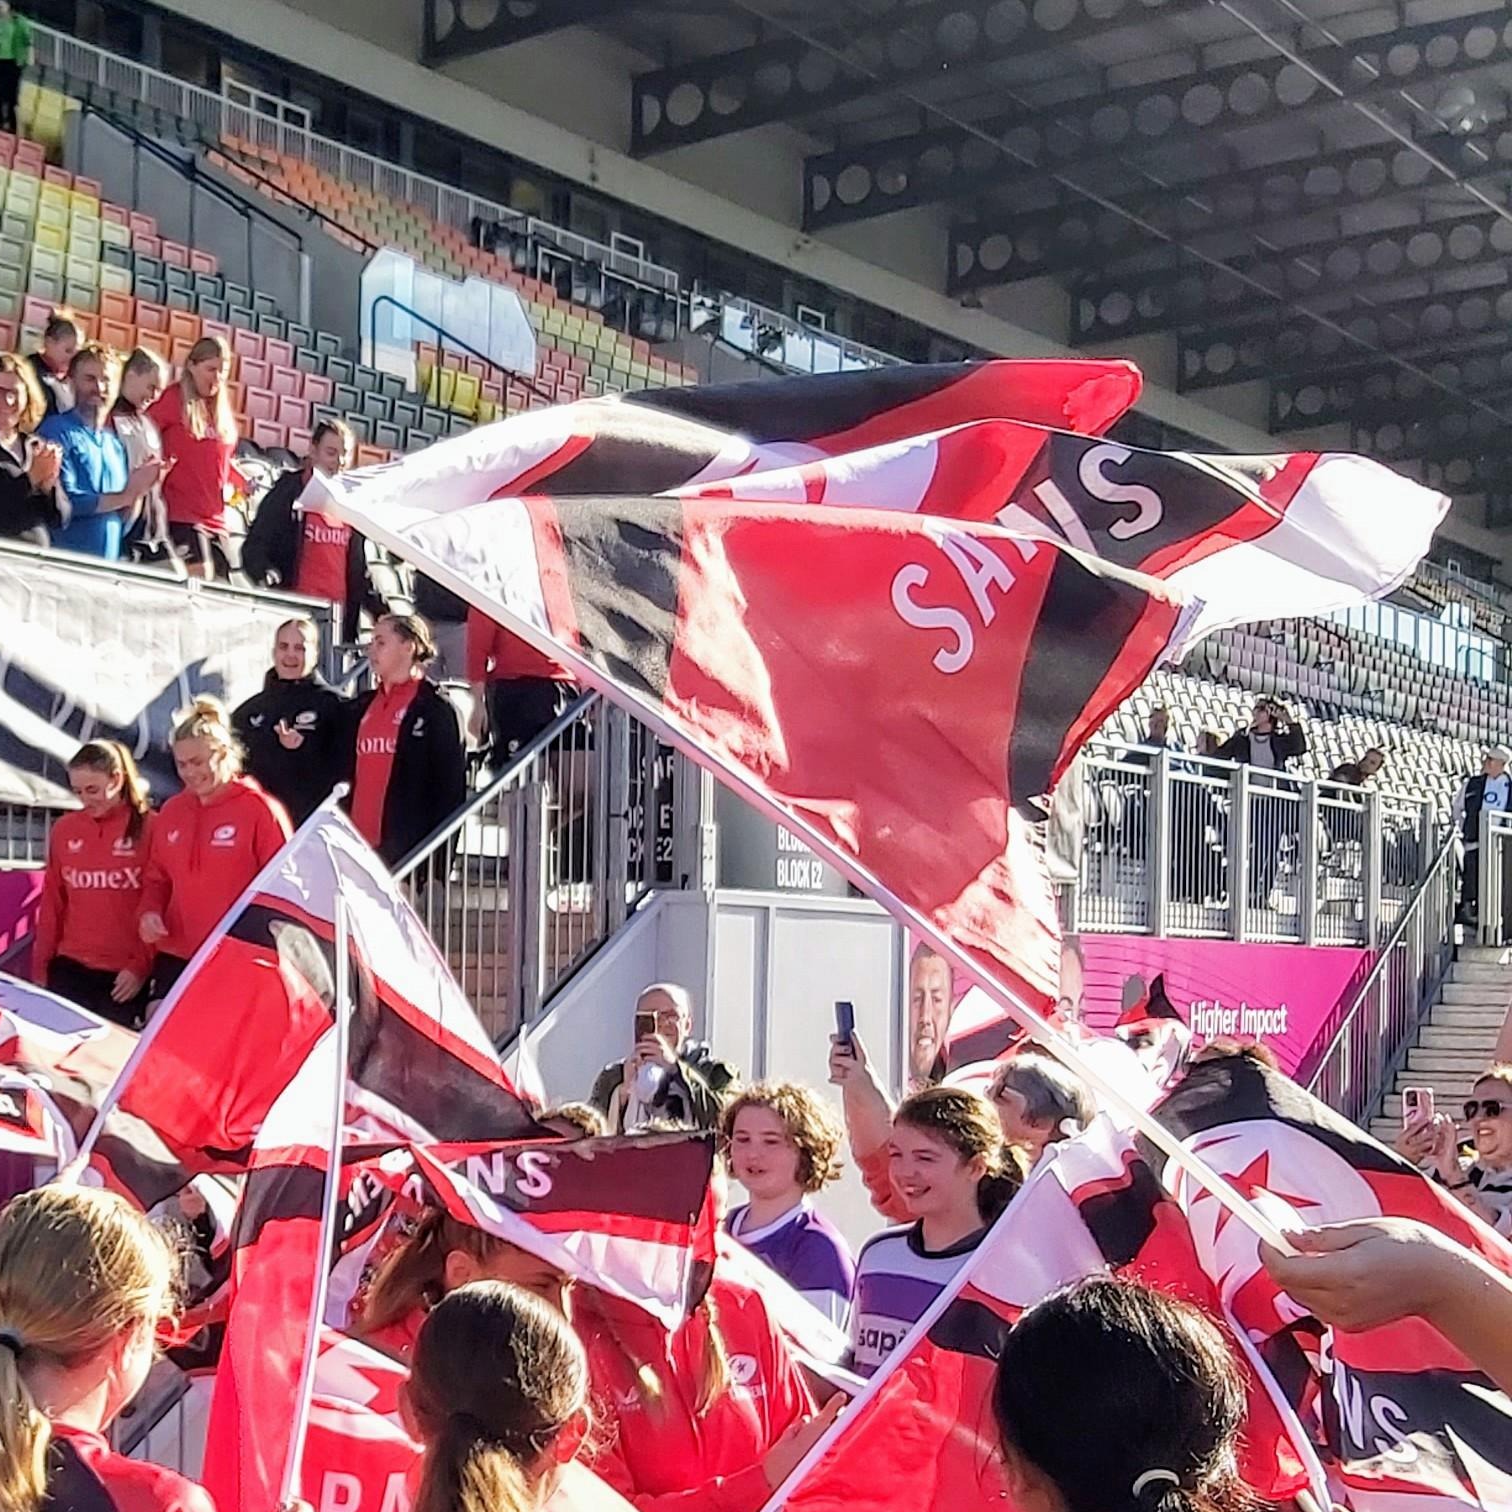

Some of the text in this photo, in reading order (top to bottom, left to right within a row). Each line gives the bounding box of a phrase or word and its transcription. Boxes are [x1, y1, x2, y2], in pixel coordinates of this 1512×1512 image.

[60, 864, 142, 889] StoneX
[776, 859, 823, 889] BLOCK E2
[1190, 1000, 1288, 1044] Higher Impact
